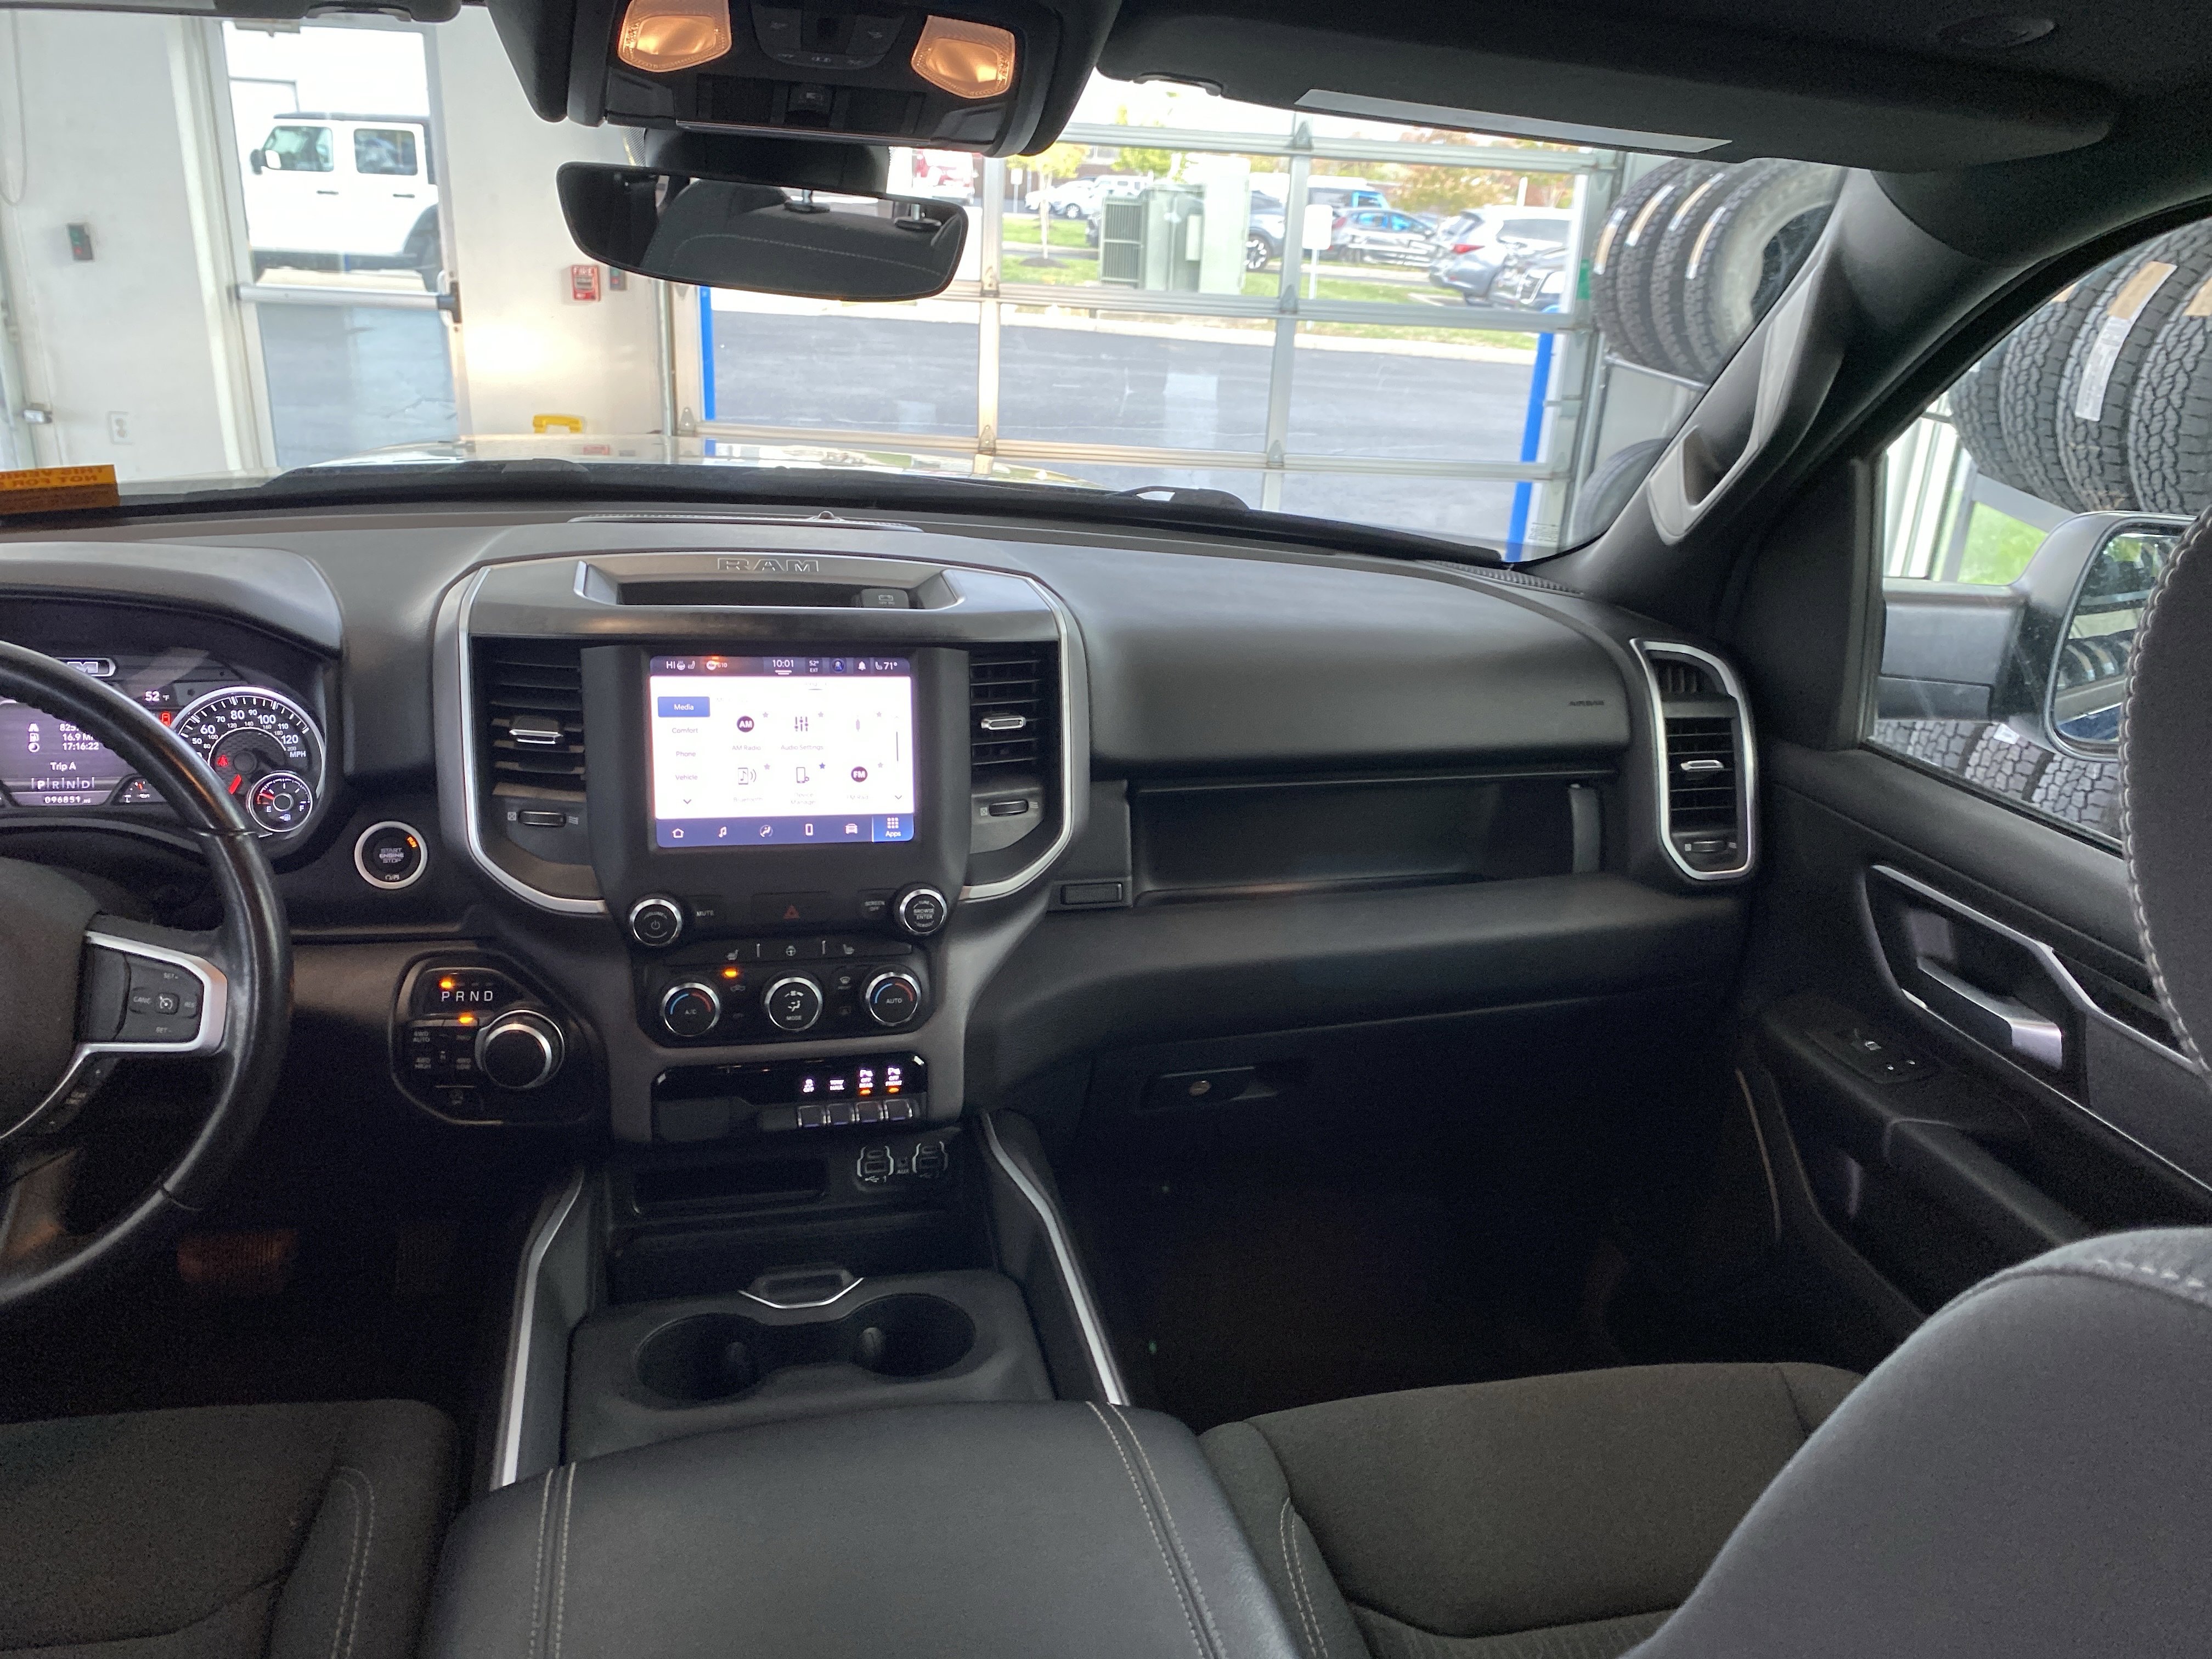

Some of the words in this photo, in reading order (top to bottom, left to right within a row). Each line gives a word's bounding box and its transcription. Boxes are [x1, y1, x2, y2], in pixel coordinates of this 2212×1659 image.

[718, 557, 820, 572] RAM
[665, 661, 675, 669] HI
[772, 659, 794, 669] 10:01
[883, 662, 898, 670] 71°
[145, 691, 160, 702] 52
[230, 710, 245, 720] 80
[258, 714, 276, 725] 100
[200, 724, 216, 735] 60
[738, 720, 753, 729] AM
[63, 733, 81, 741] 16.9
[281, 734, 298, 744] 120
[63, 742, 99, 751] 17:16:22
[50, 761, 67, 771] Trip
[69, 761, 76, 770] A
[37, 780, 46, 789] P
[442, 991, 450, 1002] P
[456, 991, 465, 1002] R
[470, 991, 479, 1001] N
[484, 991, 493, 1001] D
